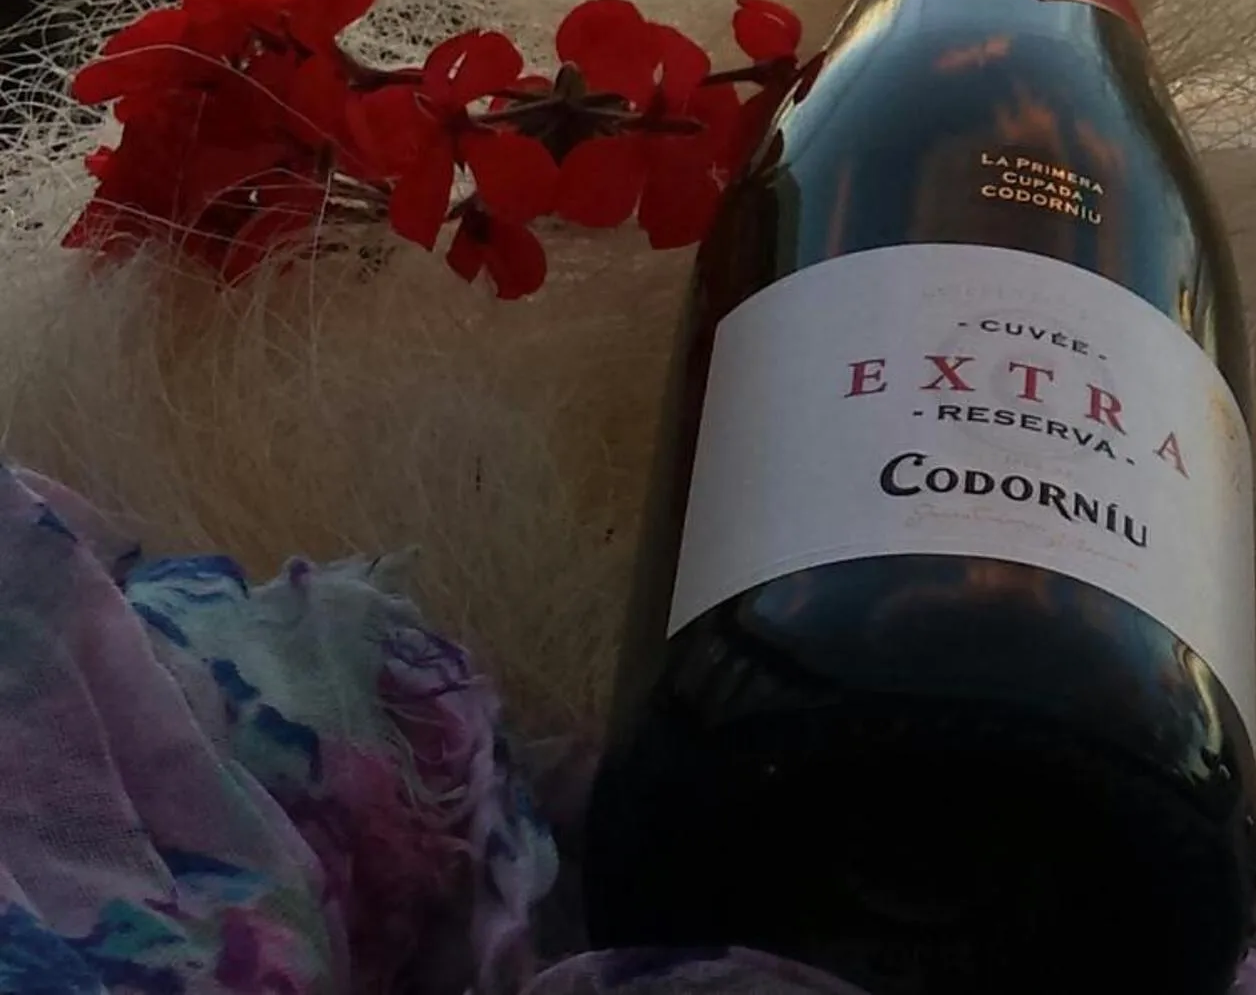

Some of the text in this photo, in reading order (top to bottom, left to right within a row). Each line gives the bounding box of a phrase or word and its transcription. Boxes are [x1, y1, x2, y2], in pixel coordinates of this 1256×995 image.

[981, 152, 1103, 195] LA PRIMERA
[1002, 171, 1083, 201] CUPADA
[844, 355, 1190, 479] EXTRA
[937, 404, 1116, 461] RESERVA
